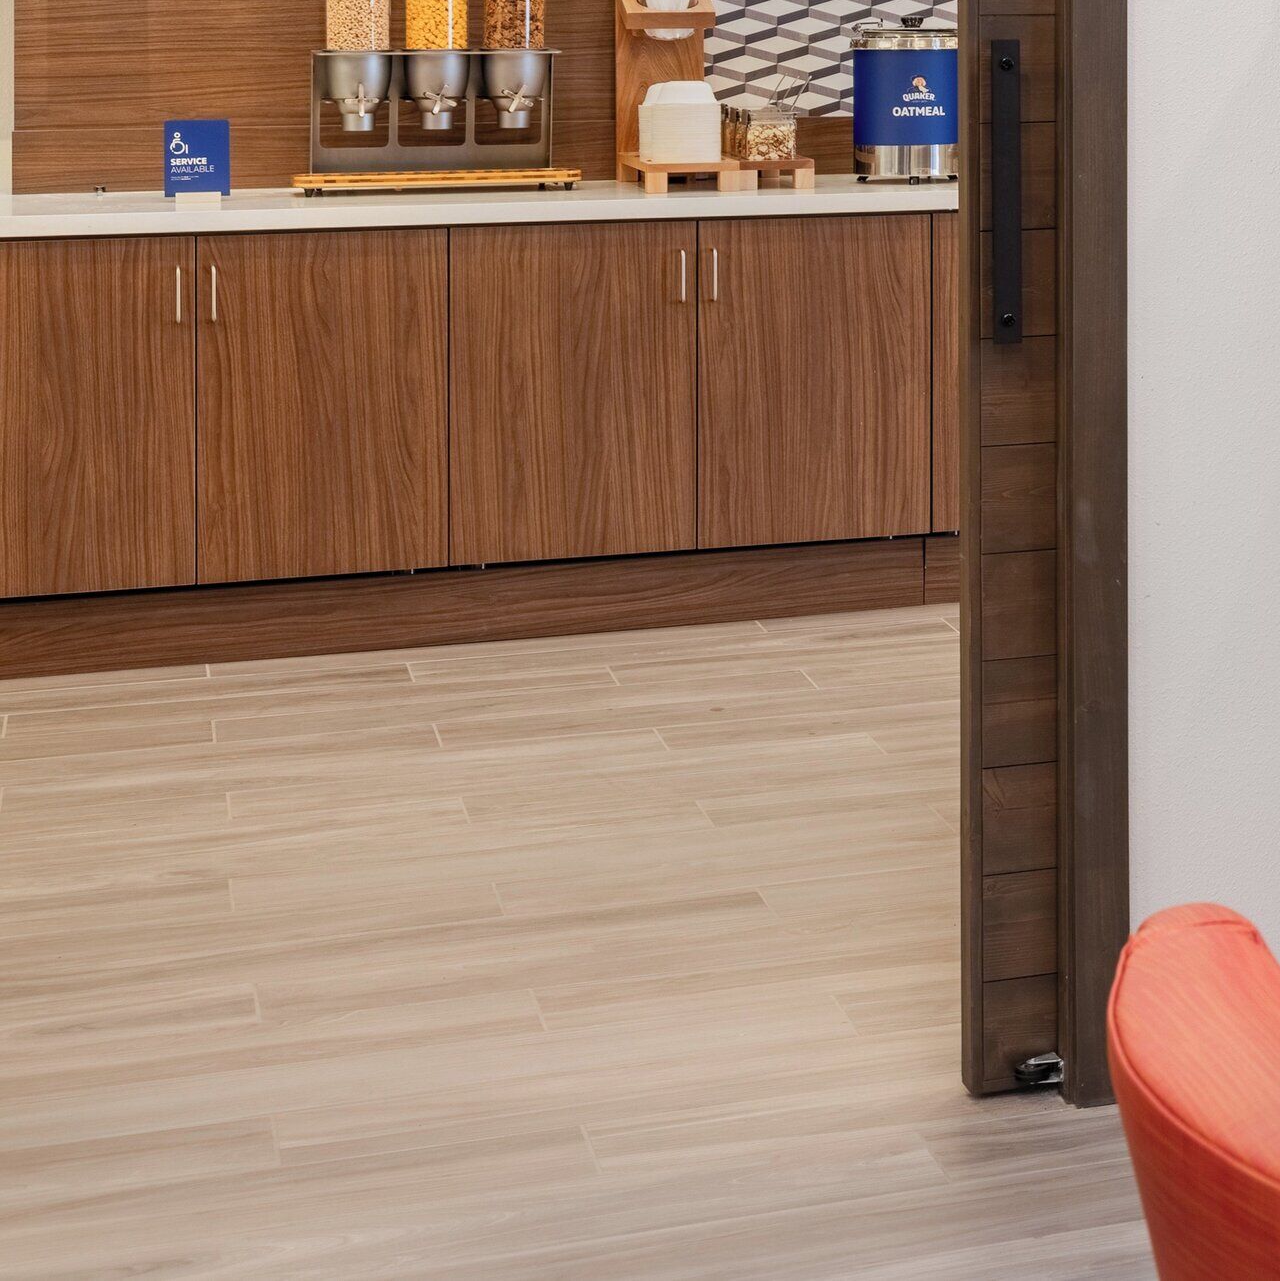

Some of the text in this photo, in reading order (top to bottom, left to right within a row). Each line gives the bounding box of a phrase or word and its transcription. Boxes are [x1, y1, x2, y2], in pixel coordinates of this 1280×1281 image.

[902, 92, 936, 102] QUAKER
[892, 106, 946, 117] OATMEAL
[170, 158, 208, 166] SERVICE
[170, 165, 215, 174] AVAILABLE
